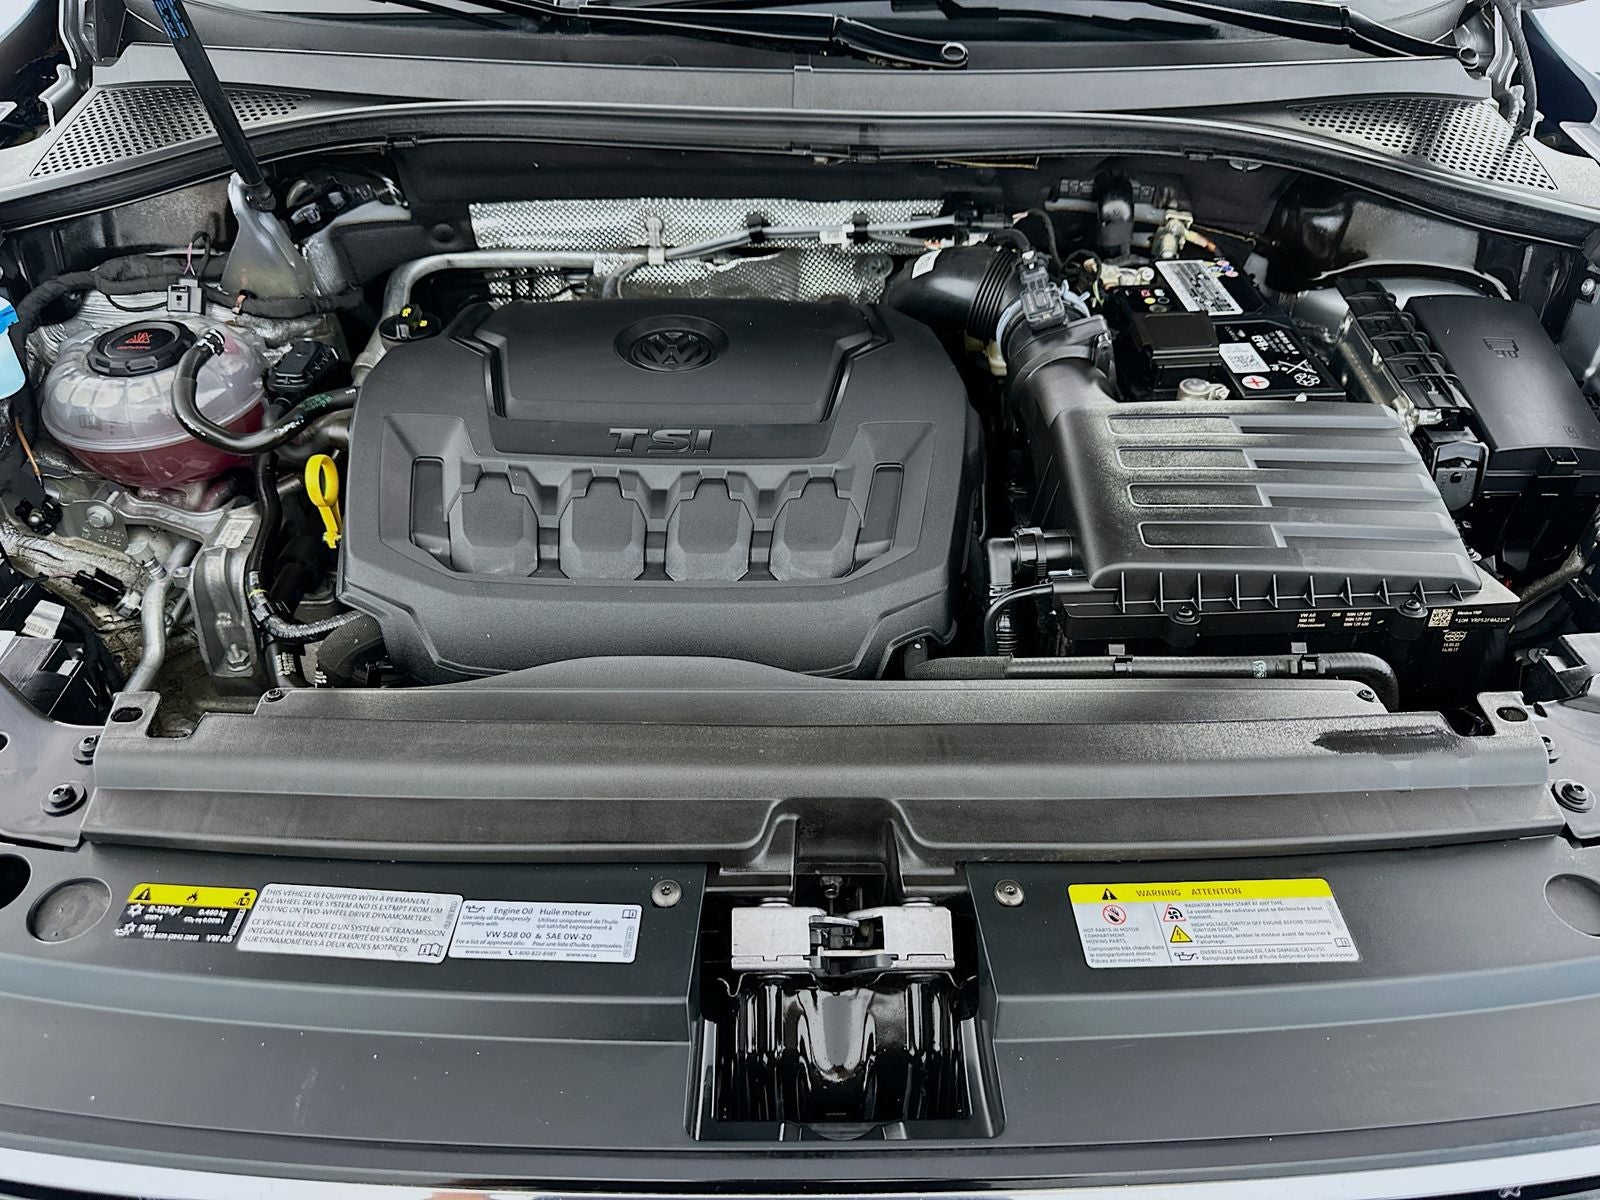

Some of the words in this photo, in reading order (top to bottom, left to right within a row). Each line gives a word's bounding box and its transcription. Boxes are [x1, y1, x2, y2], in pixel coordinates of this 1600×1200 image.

[608, 428, 715, 454] TSI
[321, 891, 357, 900] EQUIPPED
[385, 896, 430, 904] PERMANENT
[1136, 889, 1180, 897] WARNING
[1191, 888, 1241, 896] ATTENTION
[262, 897, 300, 905] ALL-WHEEL
[325, 900, 352, 908] SYSTEM
[259, 905, 288, 913] TESTING
[302, 908, 347, 916] TWO-WHEEL
[349, 910, 370, 918] DRIVE
[493, 907, 520, 916] Engine
[540, 908, 560, 916] Huile
[286, 929, 328, 938] PERMANENT
[392, 927, 445, 937] TRANSMISSION
[326, 940, 346, 948] DEUX
[346, 942, 371, 950] ROUES
